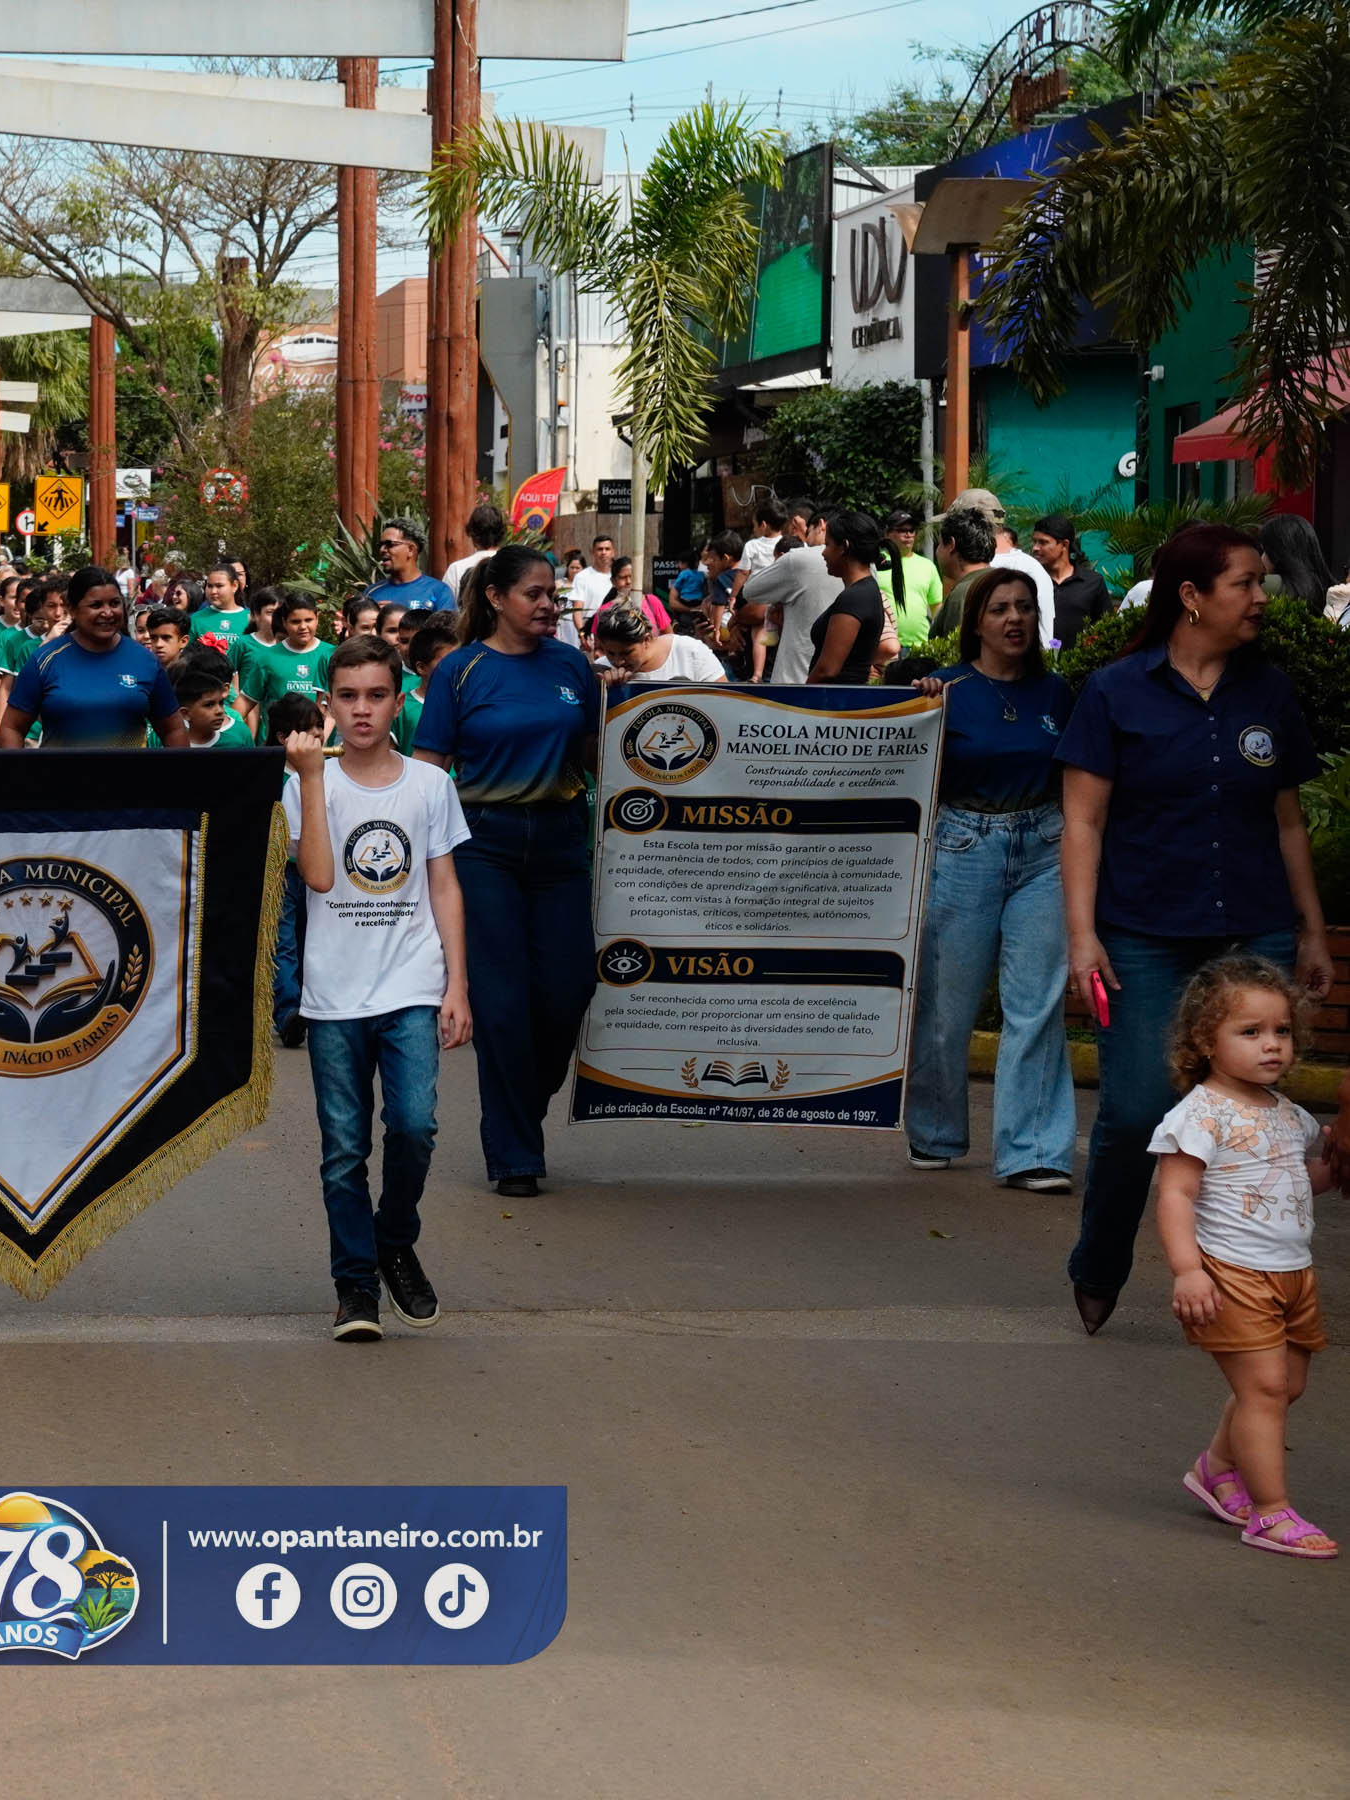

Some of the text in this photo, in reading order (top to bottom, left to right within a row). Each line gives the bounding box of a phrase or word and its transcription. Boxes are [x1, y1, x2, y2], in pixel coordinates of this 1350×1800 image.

[519, 493, 540, 503] AQUI
[633, 704, 712, 733] ESCOLA MUNICIPAL
[737, 724, 917, 740] ESCOLA MUNICIPAL
[726, 740, 929, 757] MANOEL INÁCIO DE FARIAS
[745, 765, 809, 777] Construindo
[813, 767, 882, 777] conhecimento
[749, 776, 899, 789] responsabilidade excelência.
[682, 803, 793, 826] MISSÃO
[348, 822, 409, 847] ESCOLA MUNICIPAL
[643, 840, 665, 849] Esta
[667, 841, 700, 850] Escola
[746, 843, 783, 852] missão
[785, 845, 826, 855] garantir
[638, 854, 894, 868] permanência de todos, com princípios de igualdade
[616, 866, 903, 880] equidade, oferecendo ensino de excelência comunidade,
[638, 879, 689, 890] condições
[690, 881, 704, 890] de
[706, 882, 778, 894] aprendizagem
[780, 884, 840, 894] significativa,
[842, 884, 893, 893] atualizada
[24, 863, 137, 928] MUNICIPAL
[637, 894, 668, 903] eficaz,
[695, 896, 723, 904] vistas
[734, 895, 781, 908] formação
[783, 897, 820, 907] integral
[822, 897, 835, 906] de
[837, 898, 875, 908] sujeitos
[630, 908, 871, 920] protagonistas, críticos, competentes, autônomos,
[705, 921, 792, 932] éticos solidários.
[666, 953, 755, 976] VISÃO
[630, 993, 646, 1002] Ser
[648, 995, 707, 1005] reconhecida
[760, 998, 791, 1006] escola
[792, 998, 805, 1006] de
[807, 998, 857, 1007] excelência
[604, 1007, 625, 1016] pela
[626, 1008, 679, 1018] sociedade,
[701, 1011, 763, 1020] proporcionar
[784, 1011, 815, 1020] ensino
[818, 1011, 831, 1020] de
[832, 1012, 881, 1022] qualidade
[614, 1020, 663, 1030] equidade,
[689, 1024, 729, 1032] respeito
[730, 1025, 742, 1033] às
[744, 1025, 803, 1034] diversidades
[804, 1025, 835, 1034] sendo
[837, 1025, 850, 1034] de
[852, 1025, 874, 1035] fato,
[2, 1048, 53, 1065] INÁCIO
[57, 1047, 73, 1060] DE
[74, 1011, 120, 1054] FARIAS
[716, 1037, 761, 1047] inclusiva.
[589, 1102, 879, 1122] Lei de criação da Escola: nº 741/97, de 26 de agosto de 1997.
